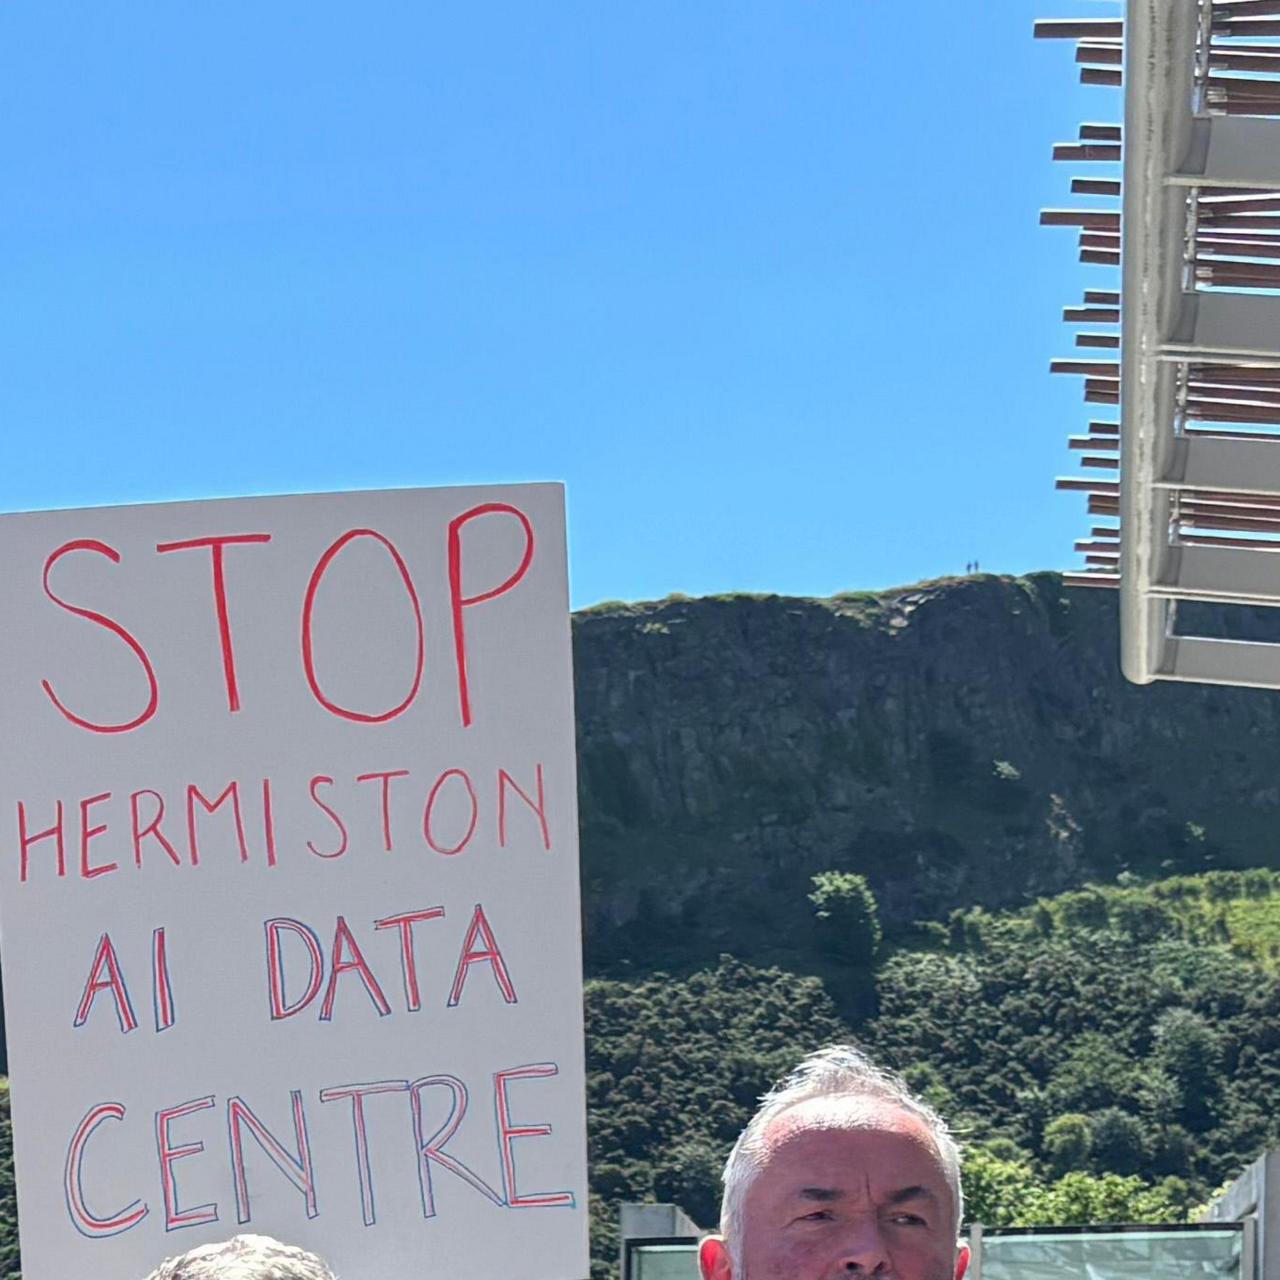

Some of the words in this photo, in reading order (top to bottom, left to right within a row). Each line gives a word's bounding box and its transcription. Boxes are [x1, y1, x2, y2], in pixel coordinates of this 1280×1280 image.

[42, 503, 533, 734] STOP
[17, 764, 550, 882] HERMISTON
[73, 927, 176, 1034] AI
[263, 903, 518, 1021] DATA
[64, 1063, 576, 1239] CENTRE
